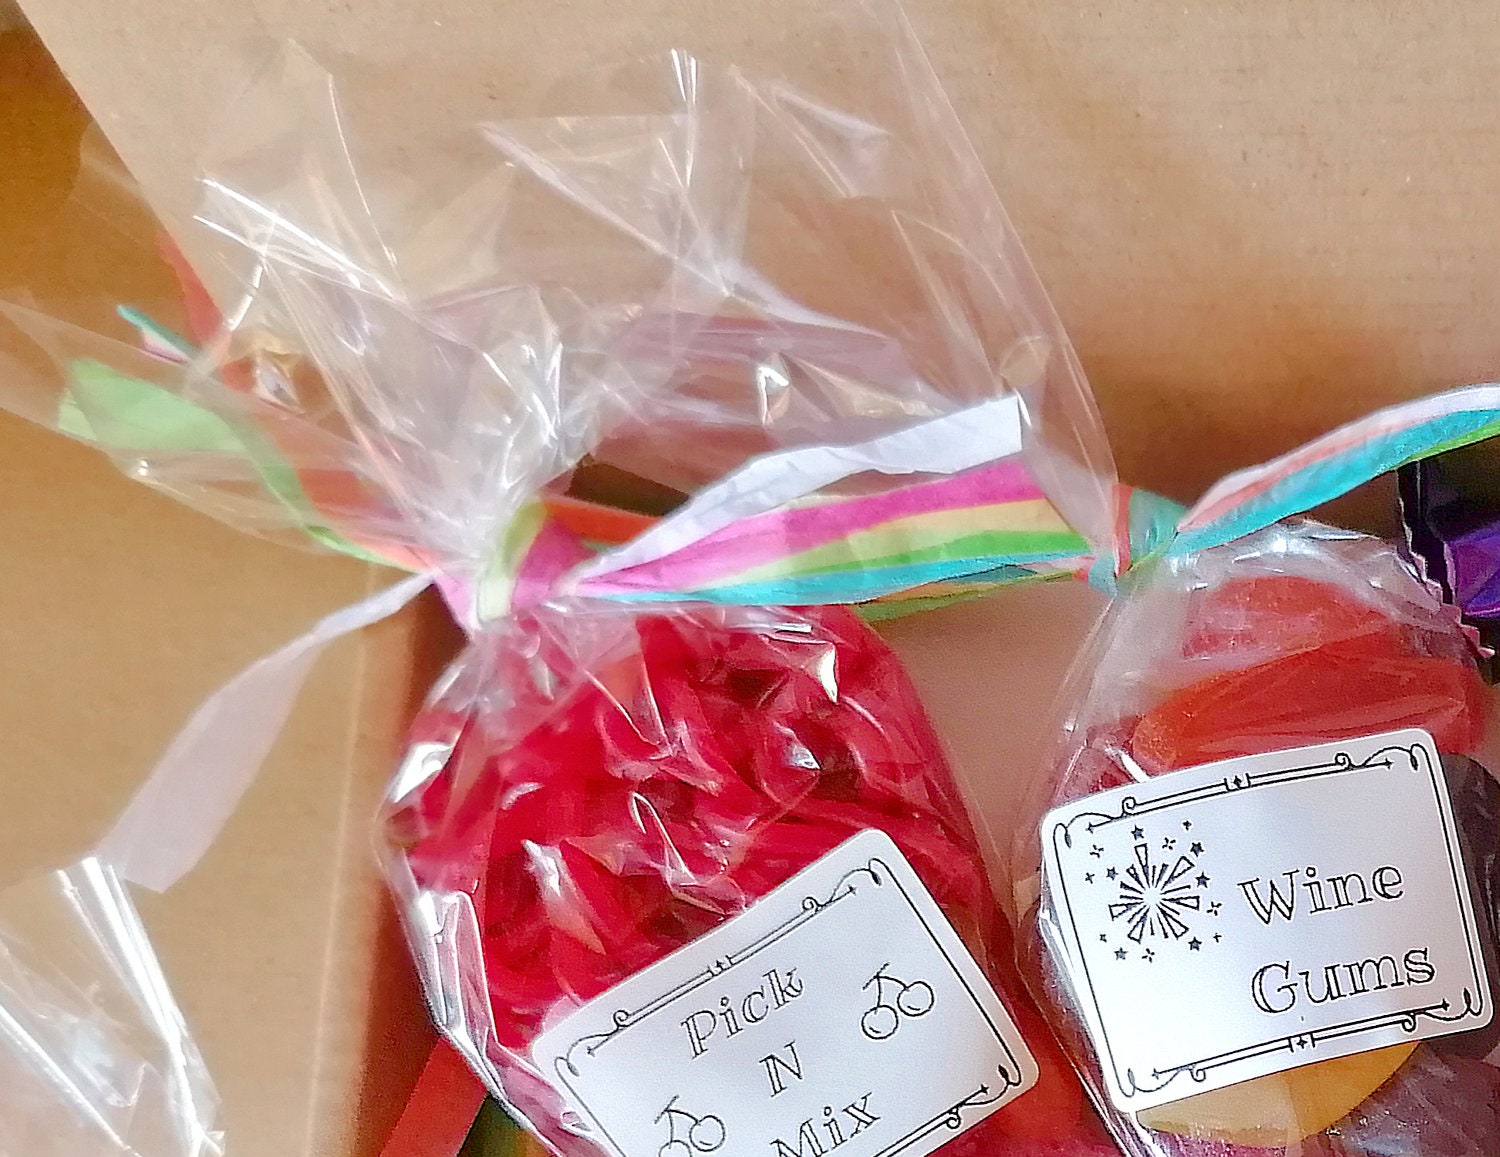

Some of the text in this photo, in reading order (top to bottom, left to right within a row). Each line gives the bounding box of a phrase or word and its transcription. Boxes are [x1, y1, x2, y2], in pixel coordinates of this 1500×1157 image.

[1238, 864, 1406, 927] Wine
[680, 965, 806, 1060] Pick
[1250, 947, 1437, 1014] Gums
[759, 1041, 804, 1097] N
